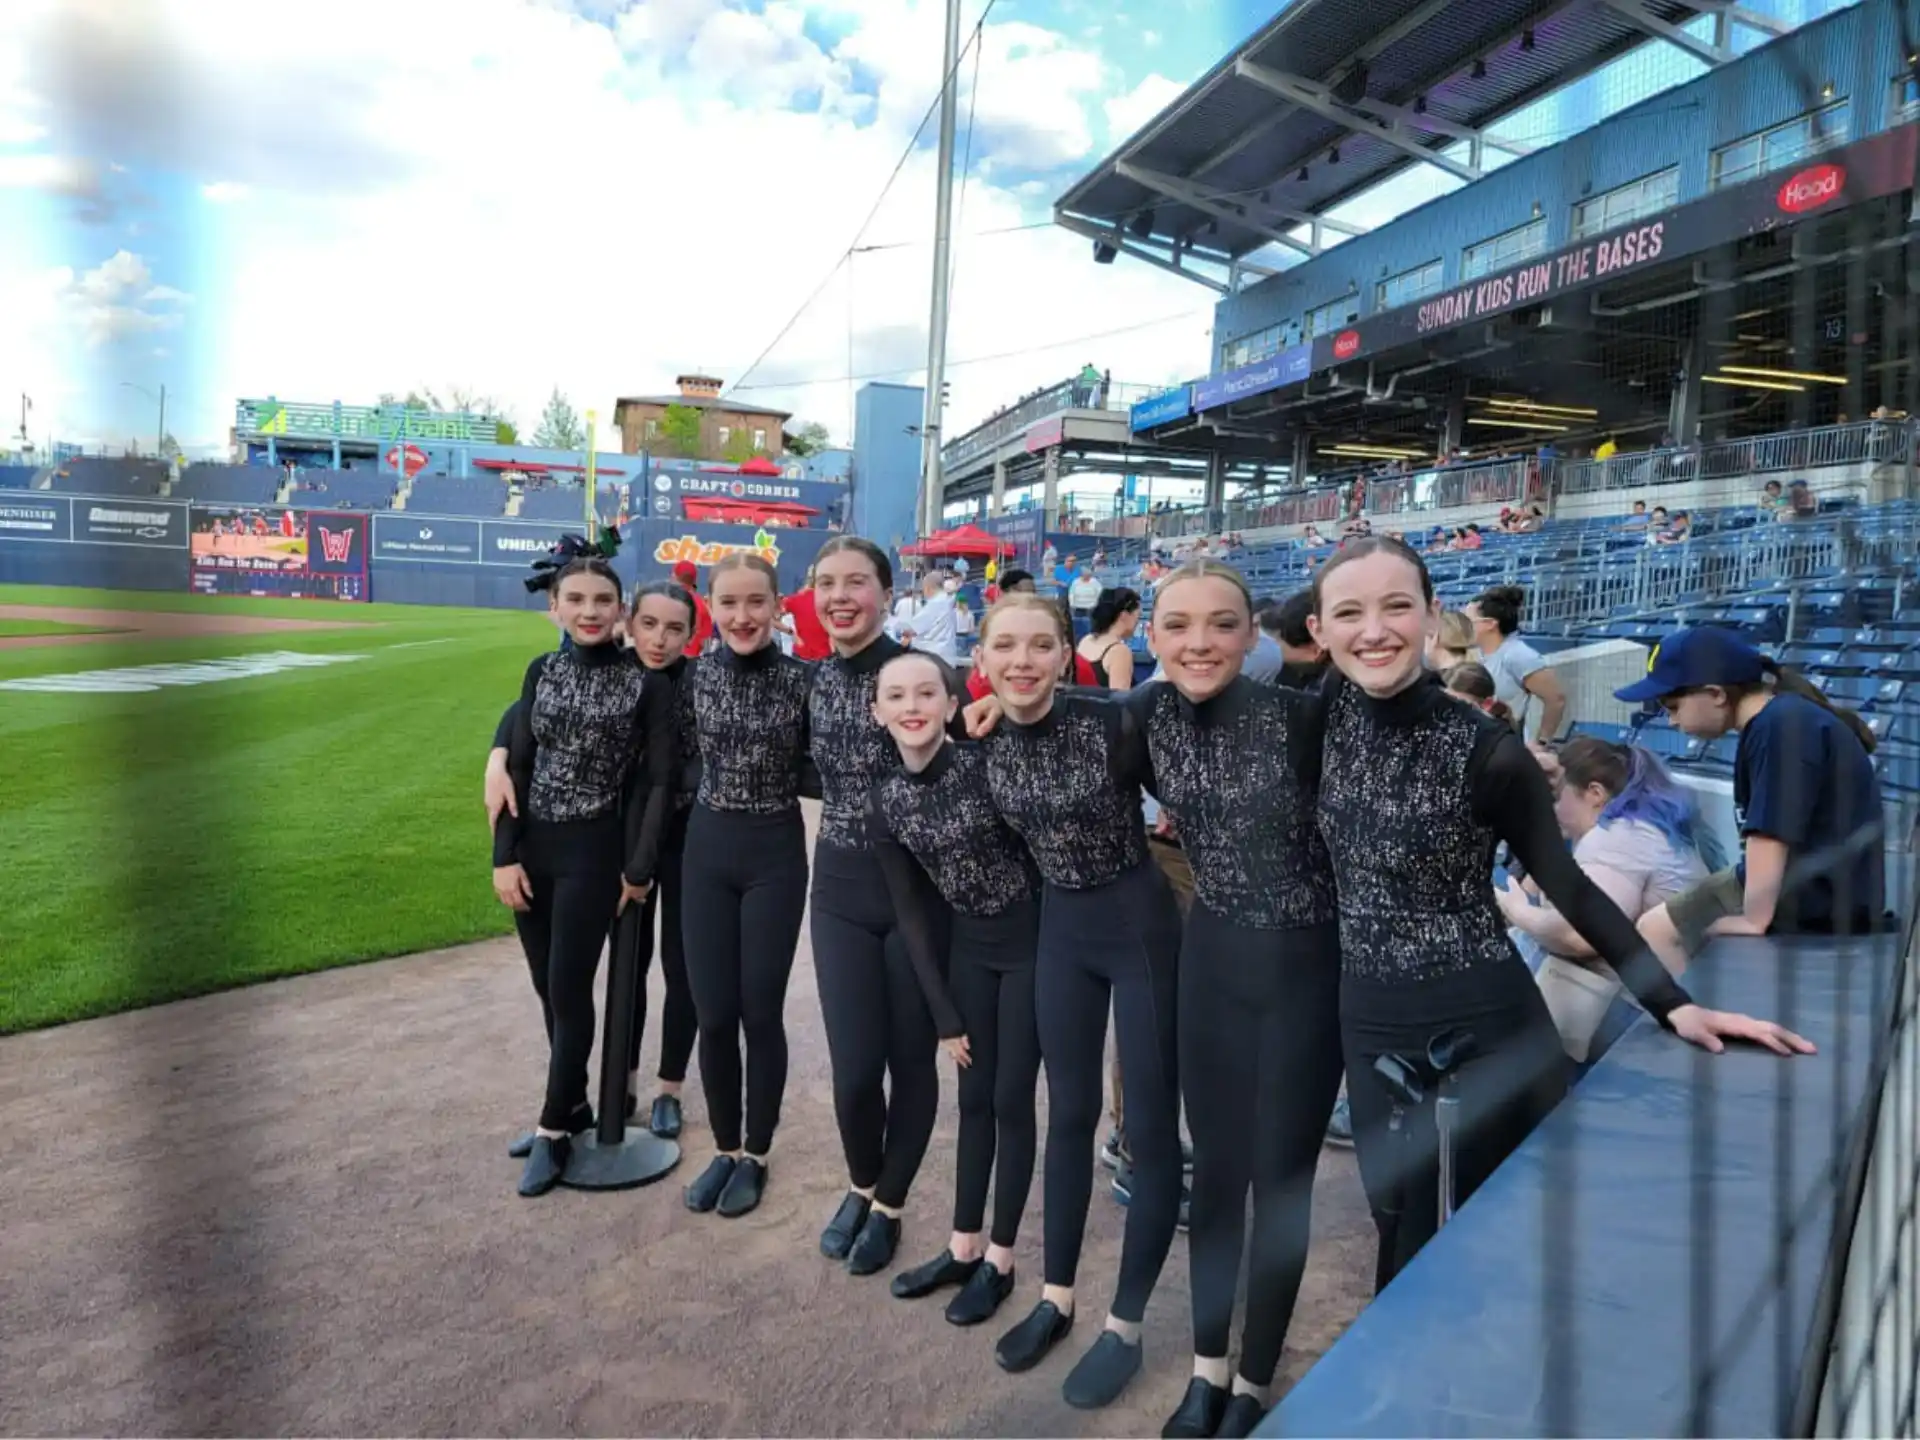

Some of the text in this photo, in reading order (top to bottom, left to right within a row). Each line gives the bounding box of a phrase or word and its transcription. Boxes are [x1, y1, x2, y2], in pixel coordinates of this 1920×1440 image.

[1785, 172, 1836, 206] Hood
[1417, 222, 1664, 332] SUNDAY KIDS RUN THE BASES
[680, 478, 800, 498] CRAFT CORNER
